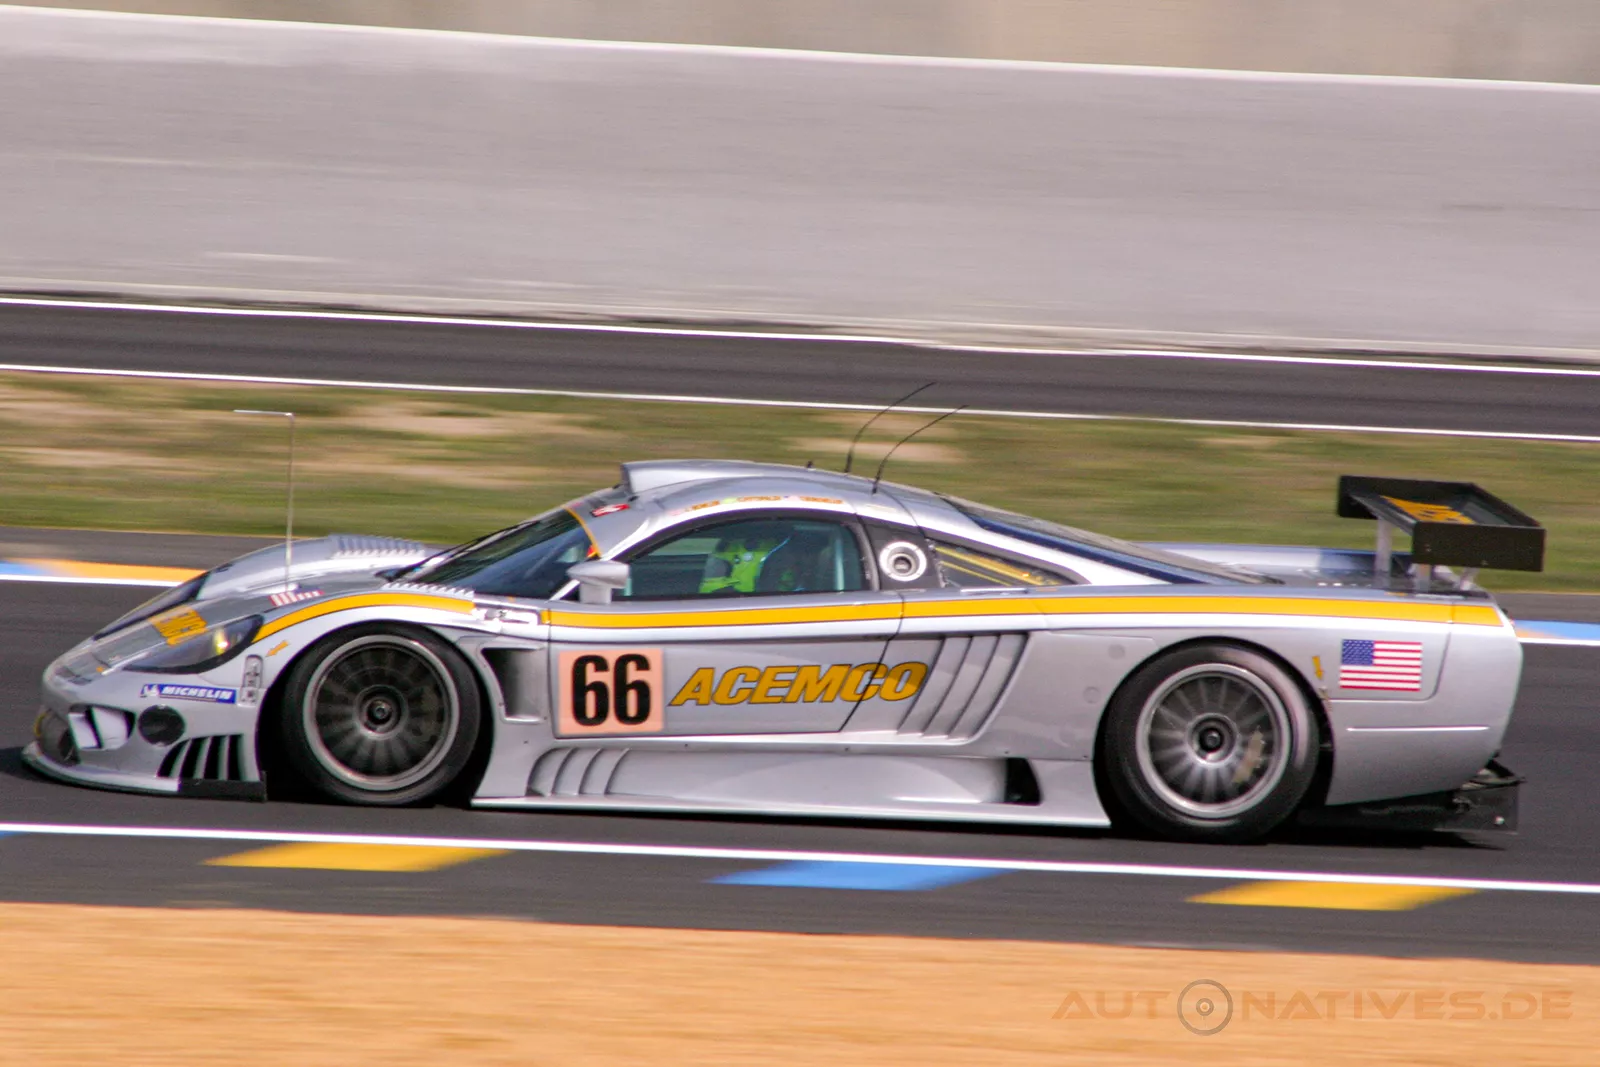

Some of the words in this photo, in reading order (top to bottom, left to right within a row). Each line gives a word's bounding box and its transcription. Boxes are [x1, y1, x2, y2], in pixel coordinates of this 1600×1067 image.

[160, 686, 233, 700] MICHELIN
[572, 654, 651, 726] 66
[667, 661, 929, 707] ACEMCO
